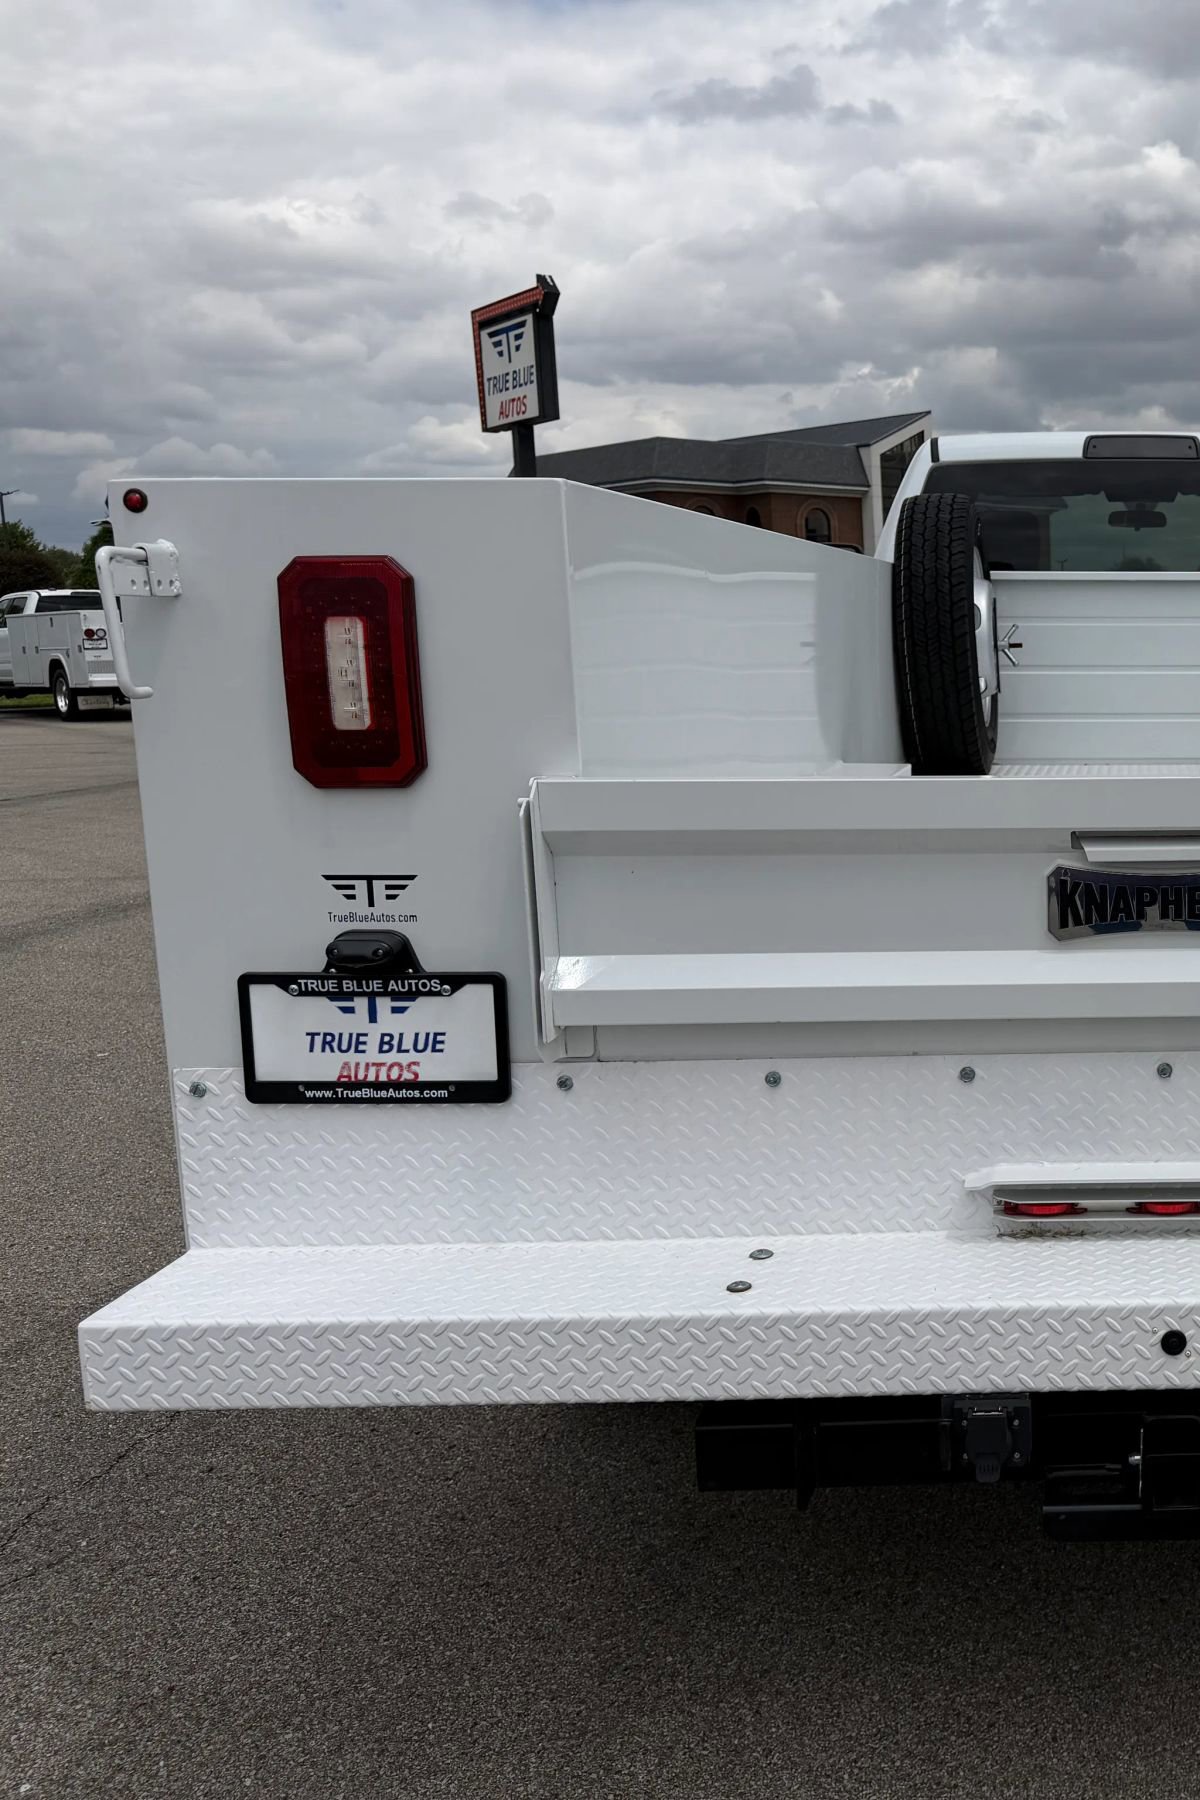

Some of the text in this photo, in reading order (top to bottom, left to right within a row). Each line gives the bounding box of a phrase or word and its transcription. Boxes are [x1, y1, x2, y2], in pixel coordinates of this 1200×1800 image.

[487, 365, 534, 396] TRUE BLUE
[499, 395, 527, 420] AUTOS
[328, 911, 418, 923] TrueBlueAutos.com
[297, 979, 441, 992] TRUE BLUE AUTOS
[305, 1032, 446, 1053] TRUE BLUE
[336, 1061, 420, 1082] AUTOS
[305, 1088, 448, 1099] www.TrueBlueAutos.com
